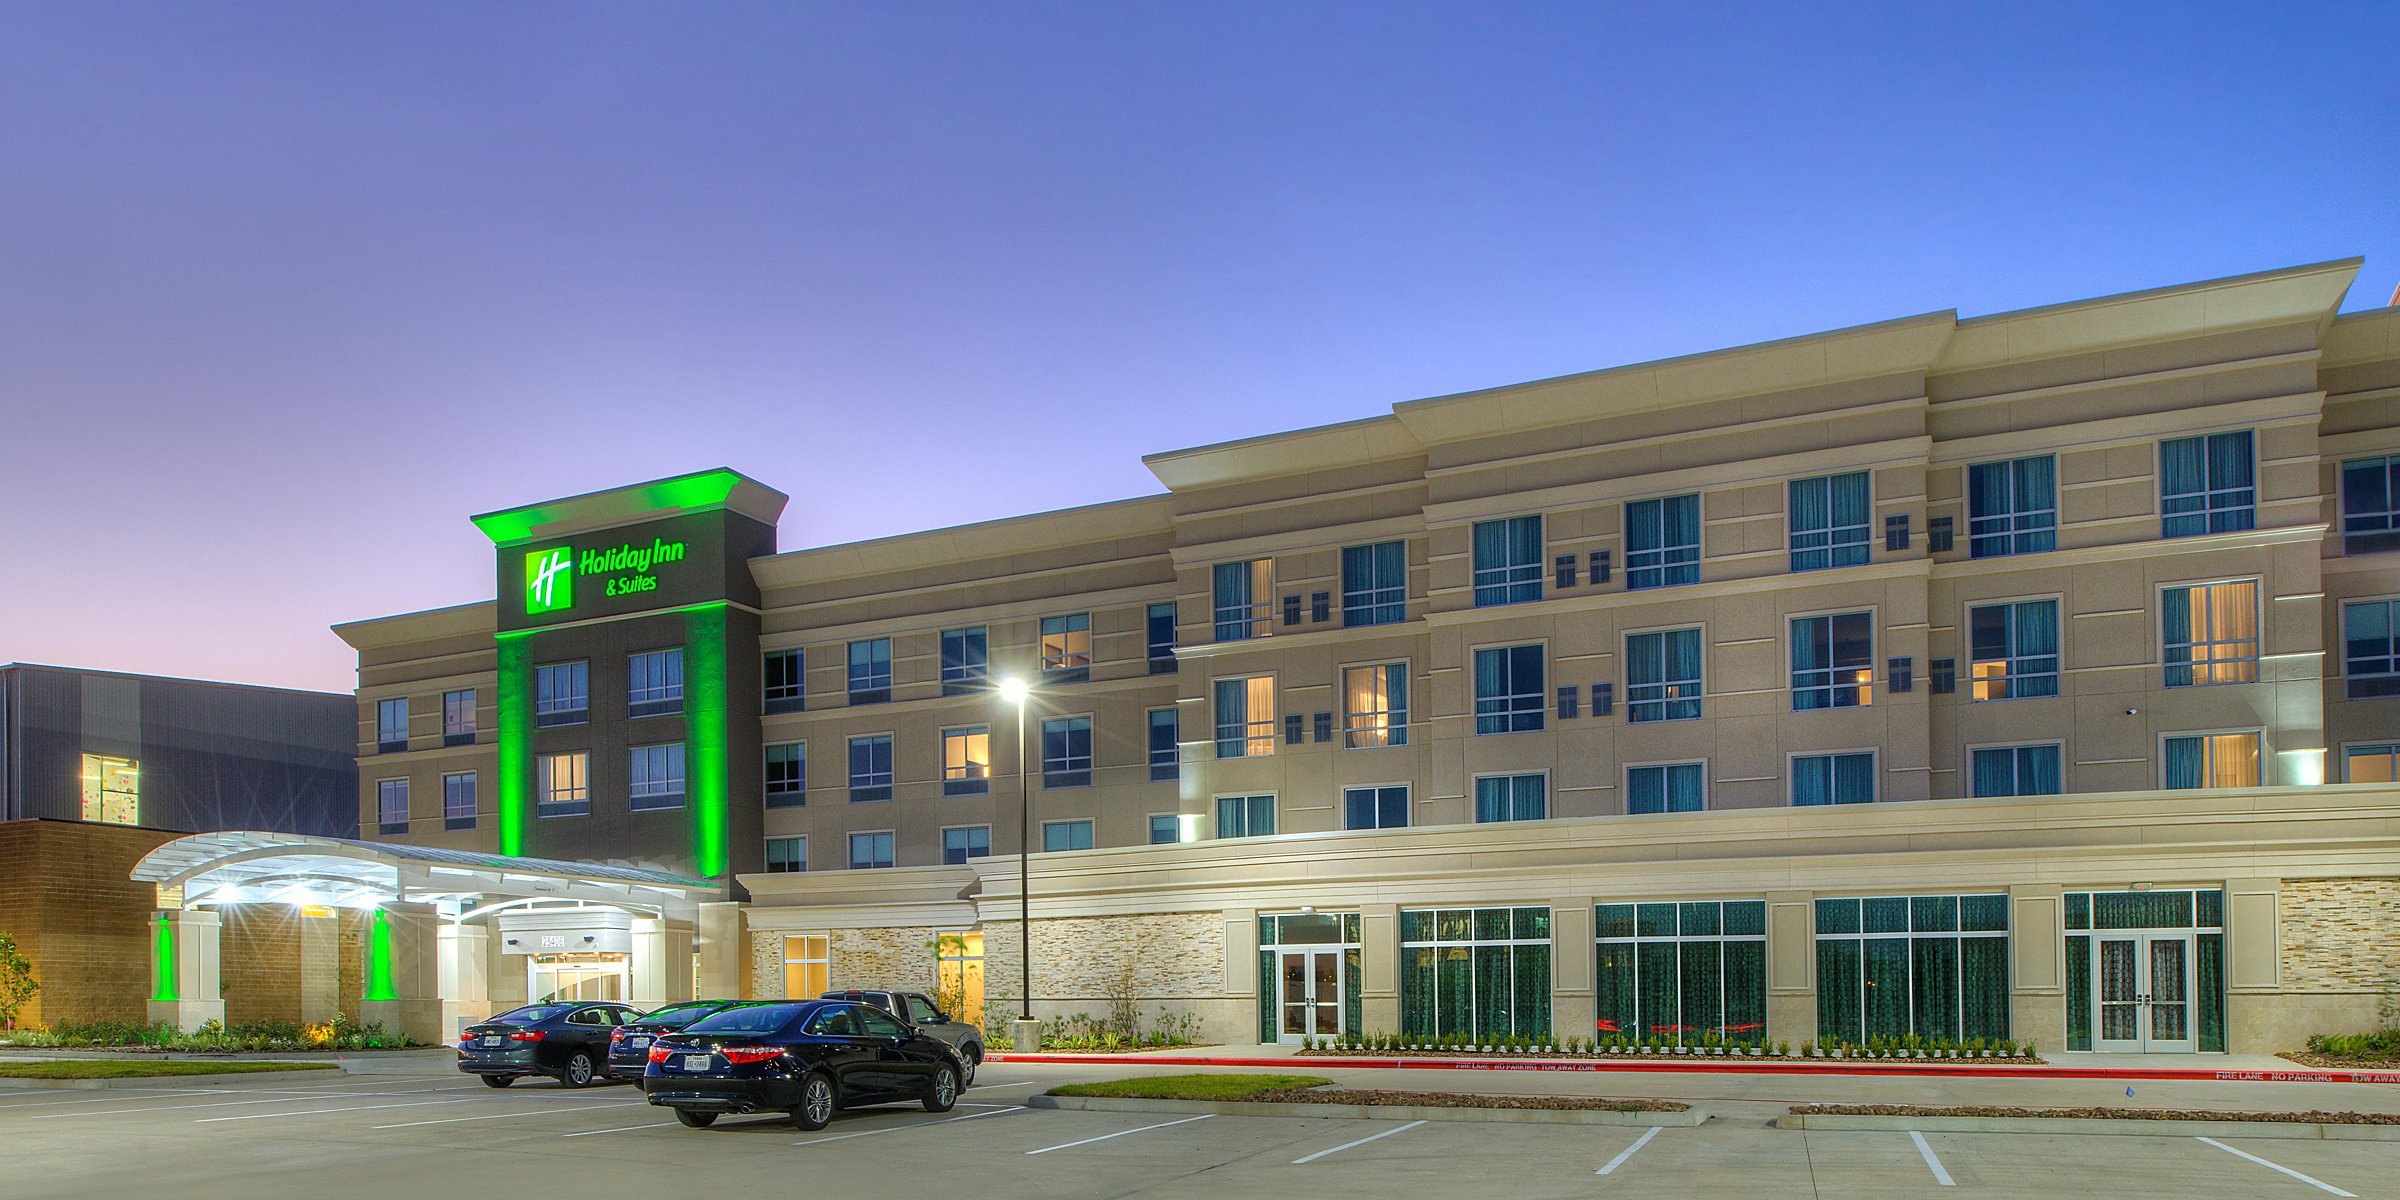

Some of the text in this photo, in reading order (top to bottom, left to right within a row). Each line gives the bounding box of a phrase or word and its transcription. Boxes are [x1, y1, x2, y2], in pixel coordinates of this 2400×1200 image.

[579, 538, 684, 575] Holiday Inn
[606, 575, 657, 597] & Suites
[1472, 1062, 1489, 1070] LANE
[1506, 1063, 1537, 1071] PARKING
[2216, 1072, 2237, 1080] FIRE
[2239, 1072, 2264, 1081] LANE
[2271, 1073, 2286, 1081] NO
[2288, 1073, 2332, 1082] PARKING
[2351, 1074, 2371, 1083] TOW
